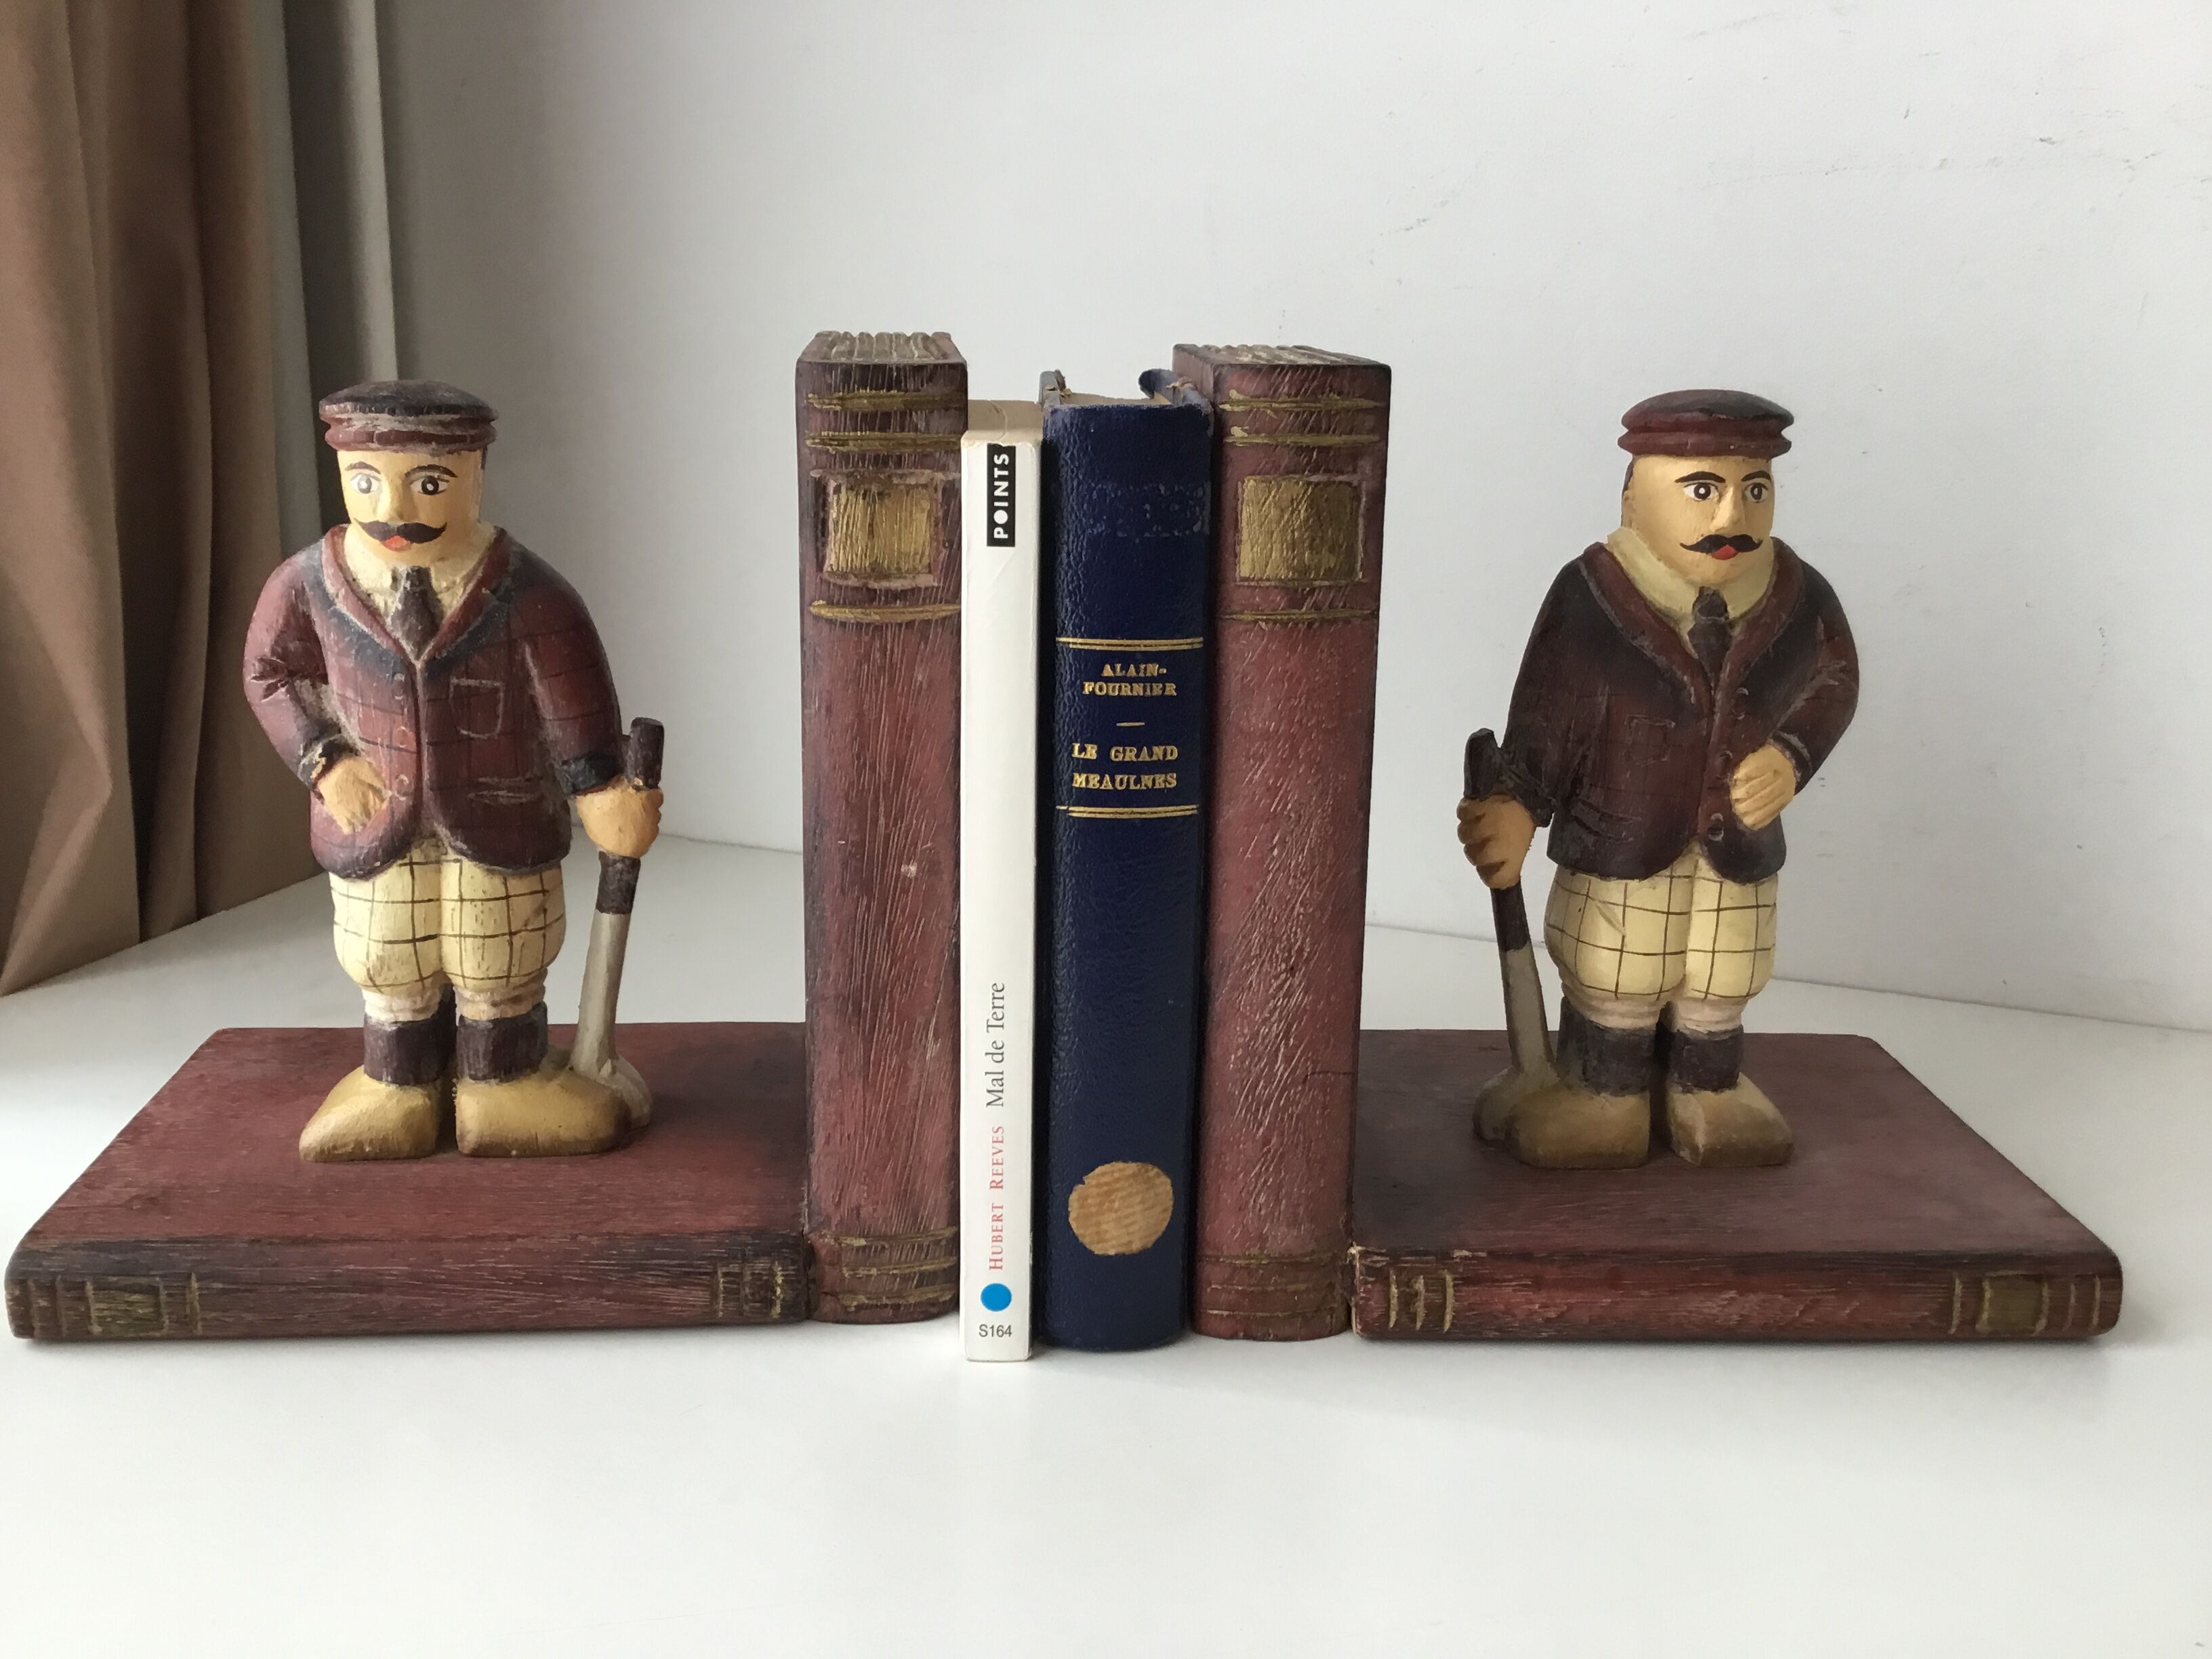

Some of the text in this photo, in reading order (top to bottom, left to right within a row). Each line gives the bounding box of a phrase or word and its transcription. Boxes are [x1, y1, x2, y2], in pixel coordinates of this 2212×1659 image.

[994, 453, 1010, 539] POINTS
[1101, 663, 1167, 678] ALAIN-
[1082, 681, 1177, 697] FOURNIER
[1071, 743, 1179, 762] LE GRAND
[1072, 773, 1177, 790] MEAULNES
[985, 983, 1004, 1108] Mal de Terre
[989, 1126, 1004, 1271] HUBERT REEVES
[979, 1324, 1012, 1338] S164
